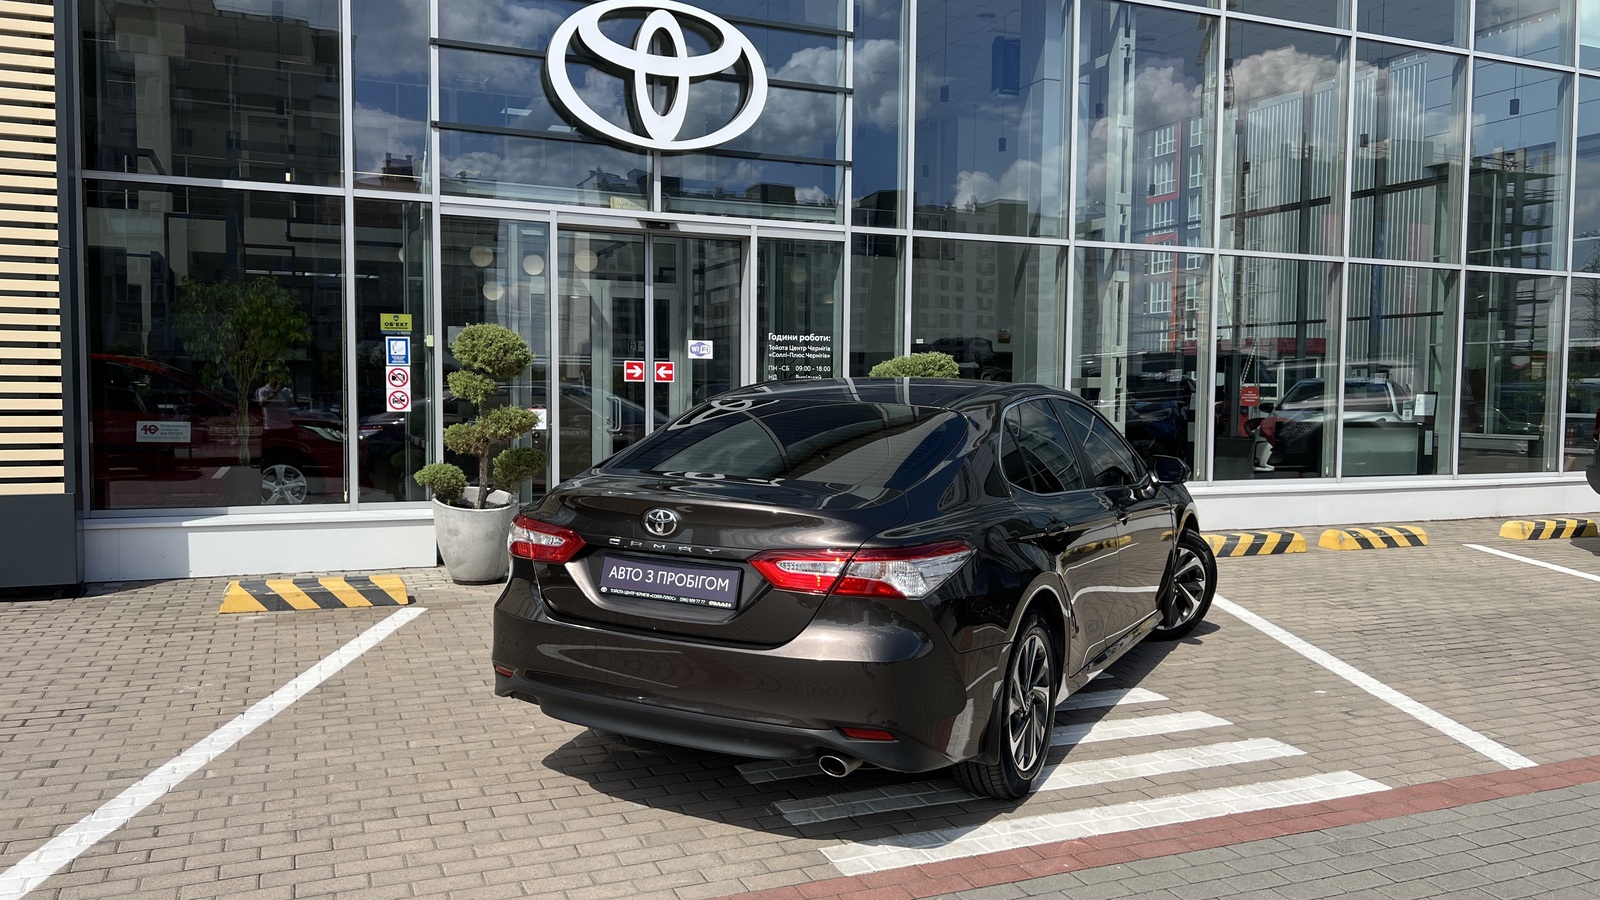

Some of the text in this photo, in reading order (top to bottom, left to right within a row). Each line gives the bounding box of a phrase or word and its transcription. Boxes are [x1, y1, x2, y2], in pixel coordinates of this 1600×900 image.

[768, 332, 831, 342] Години роботи:
[608, 537, 721, 554] CAMRY
[608, 565, 730, 592] АВТО З ПРОБІГОМ
